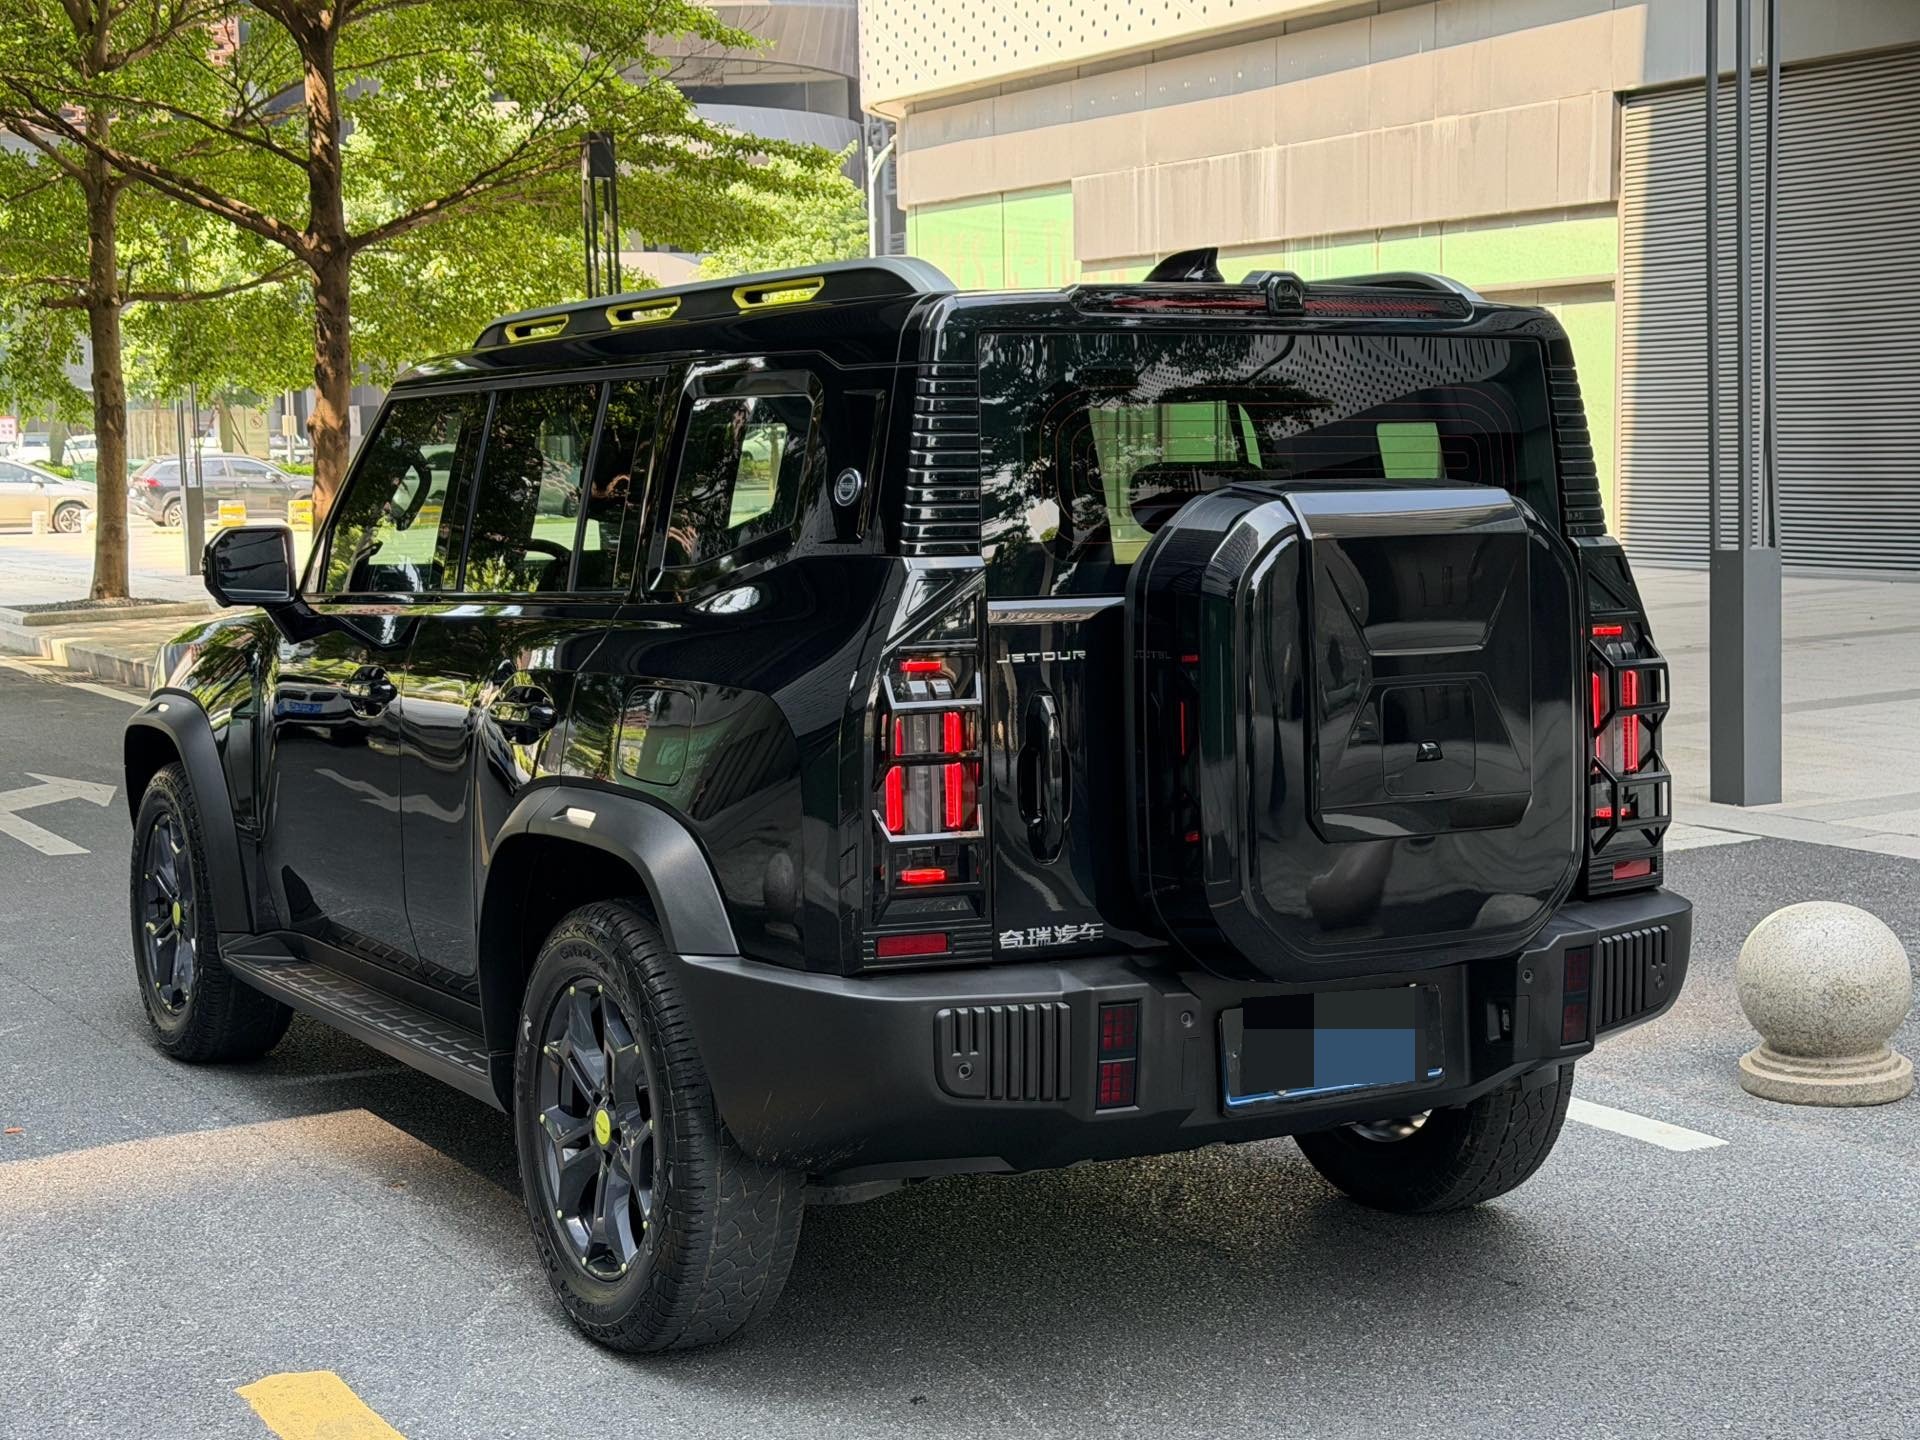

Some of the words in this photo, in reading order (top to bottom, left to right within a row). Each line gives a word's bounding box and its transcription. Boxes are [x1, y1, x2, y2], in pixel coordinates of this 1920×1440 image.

[996, 650, 1087, 664] JETOUR
[999, 922, 1104, 950] 奇瑞汽车
